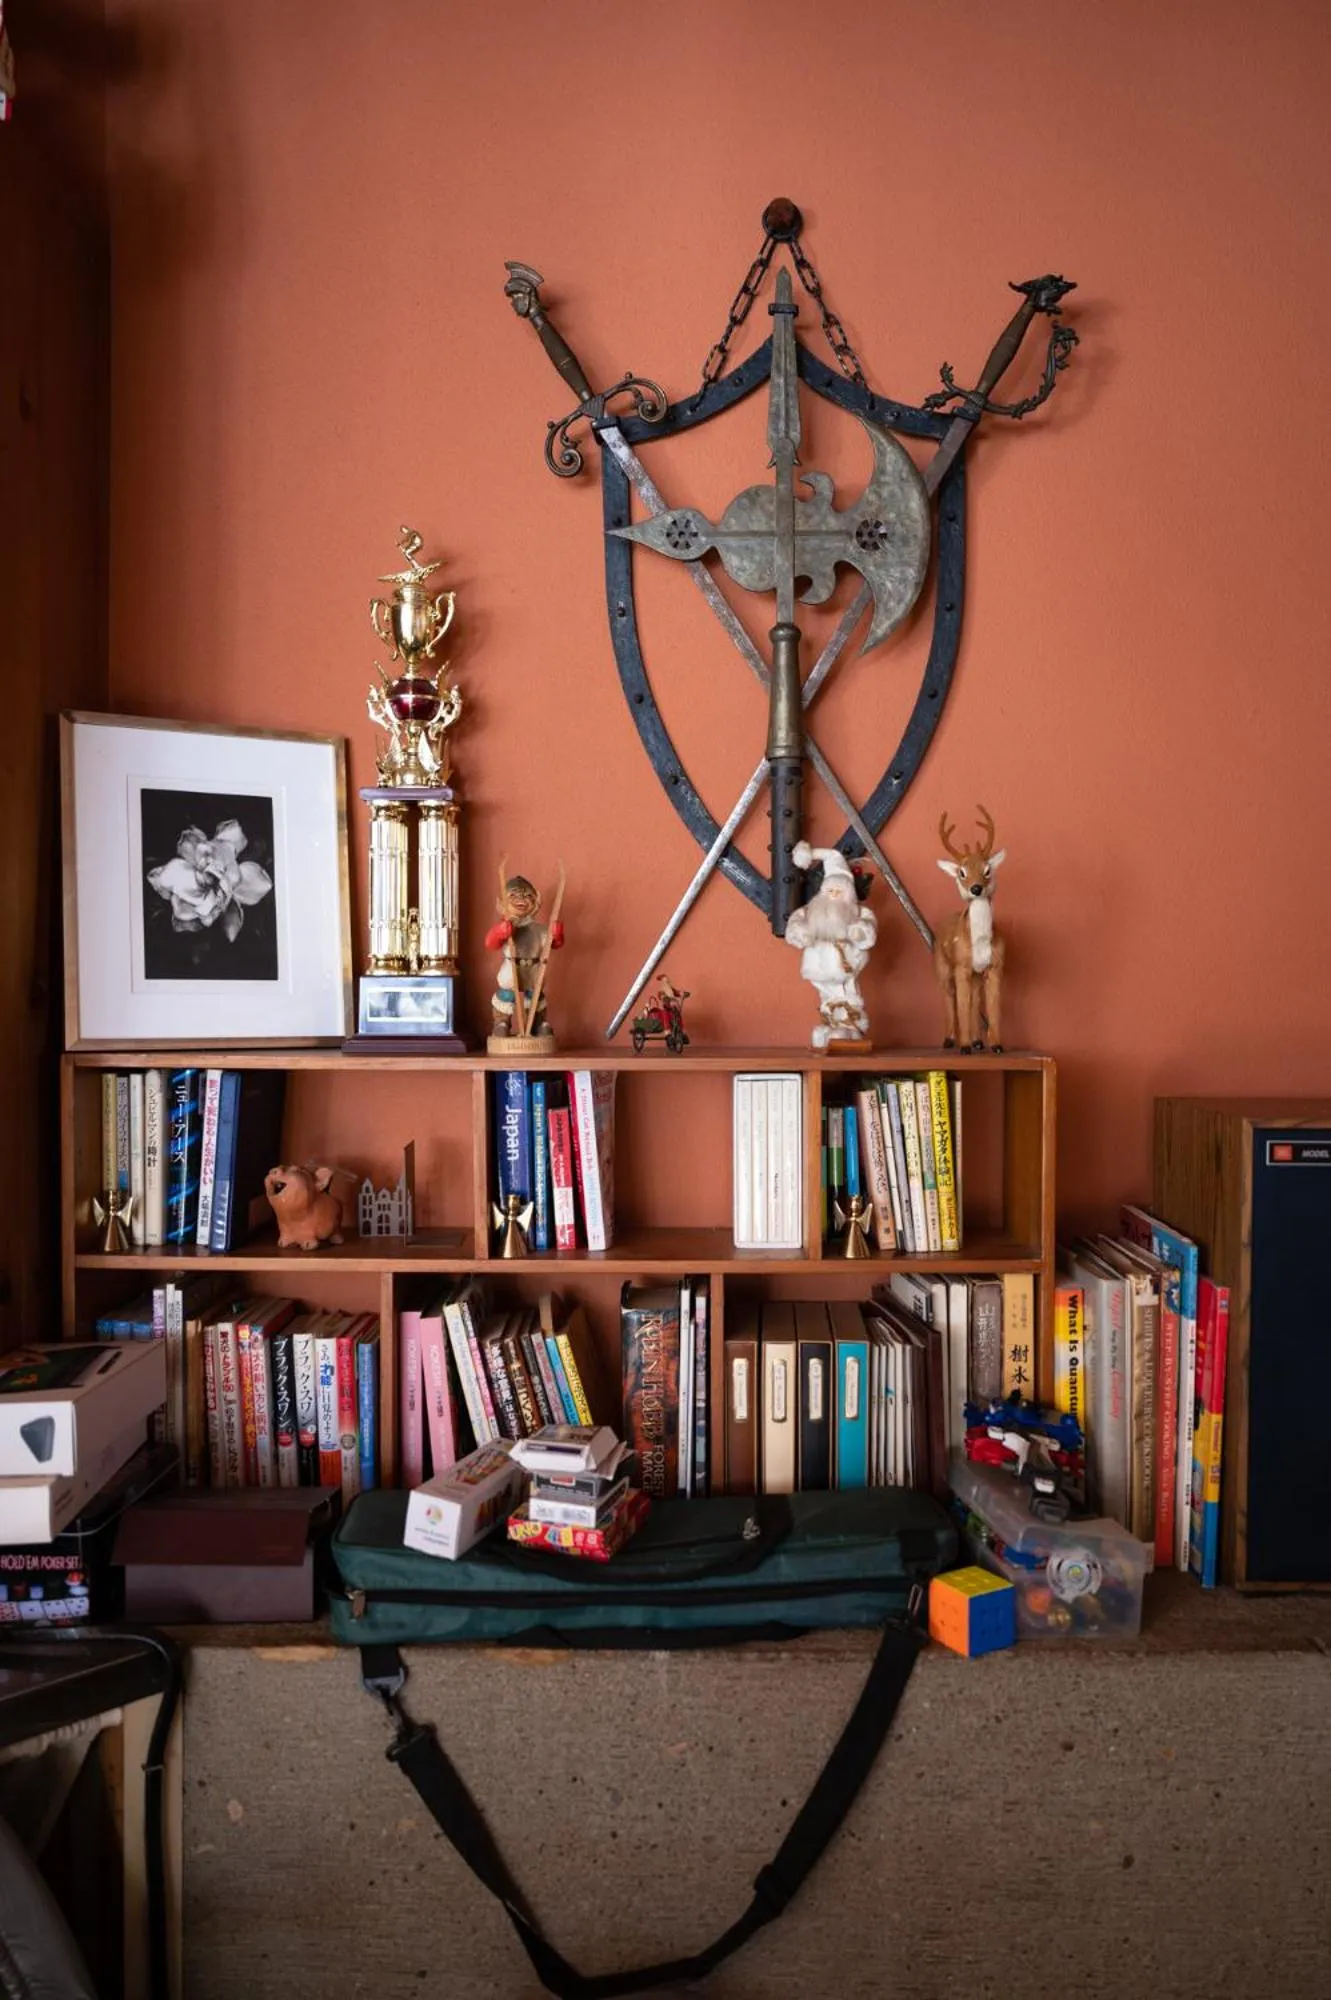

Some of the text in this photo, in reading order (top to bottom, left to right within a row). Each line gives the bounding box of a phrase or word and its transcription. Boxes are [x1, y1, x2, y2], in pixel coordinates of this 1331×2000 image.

[173, 1085, 188, 1163] ニュー・アース
[501, 1105, 522, 1160] Japan
[273, 1337, 291, 1428] ブラック・スワン
[296, 1338, 313, 1423] ブラック・スワン
[634, 1313, 663, 1439] ROBIN HOBB
[1068, 1294, 1079, 1417] What Is Quantu
[642, 1450, 654, 1493] MAGE
[653, 1444, 664, 1496] FOREST
[1142, 1421, 1152, 1488] COOKBOOK
[1162, 1410, 1172, 1461] COOKING
